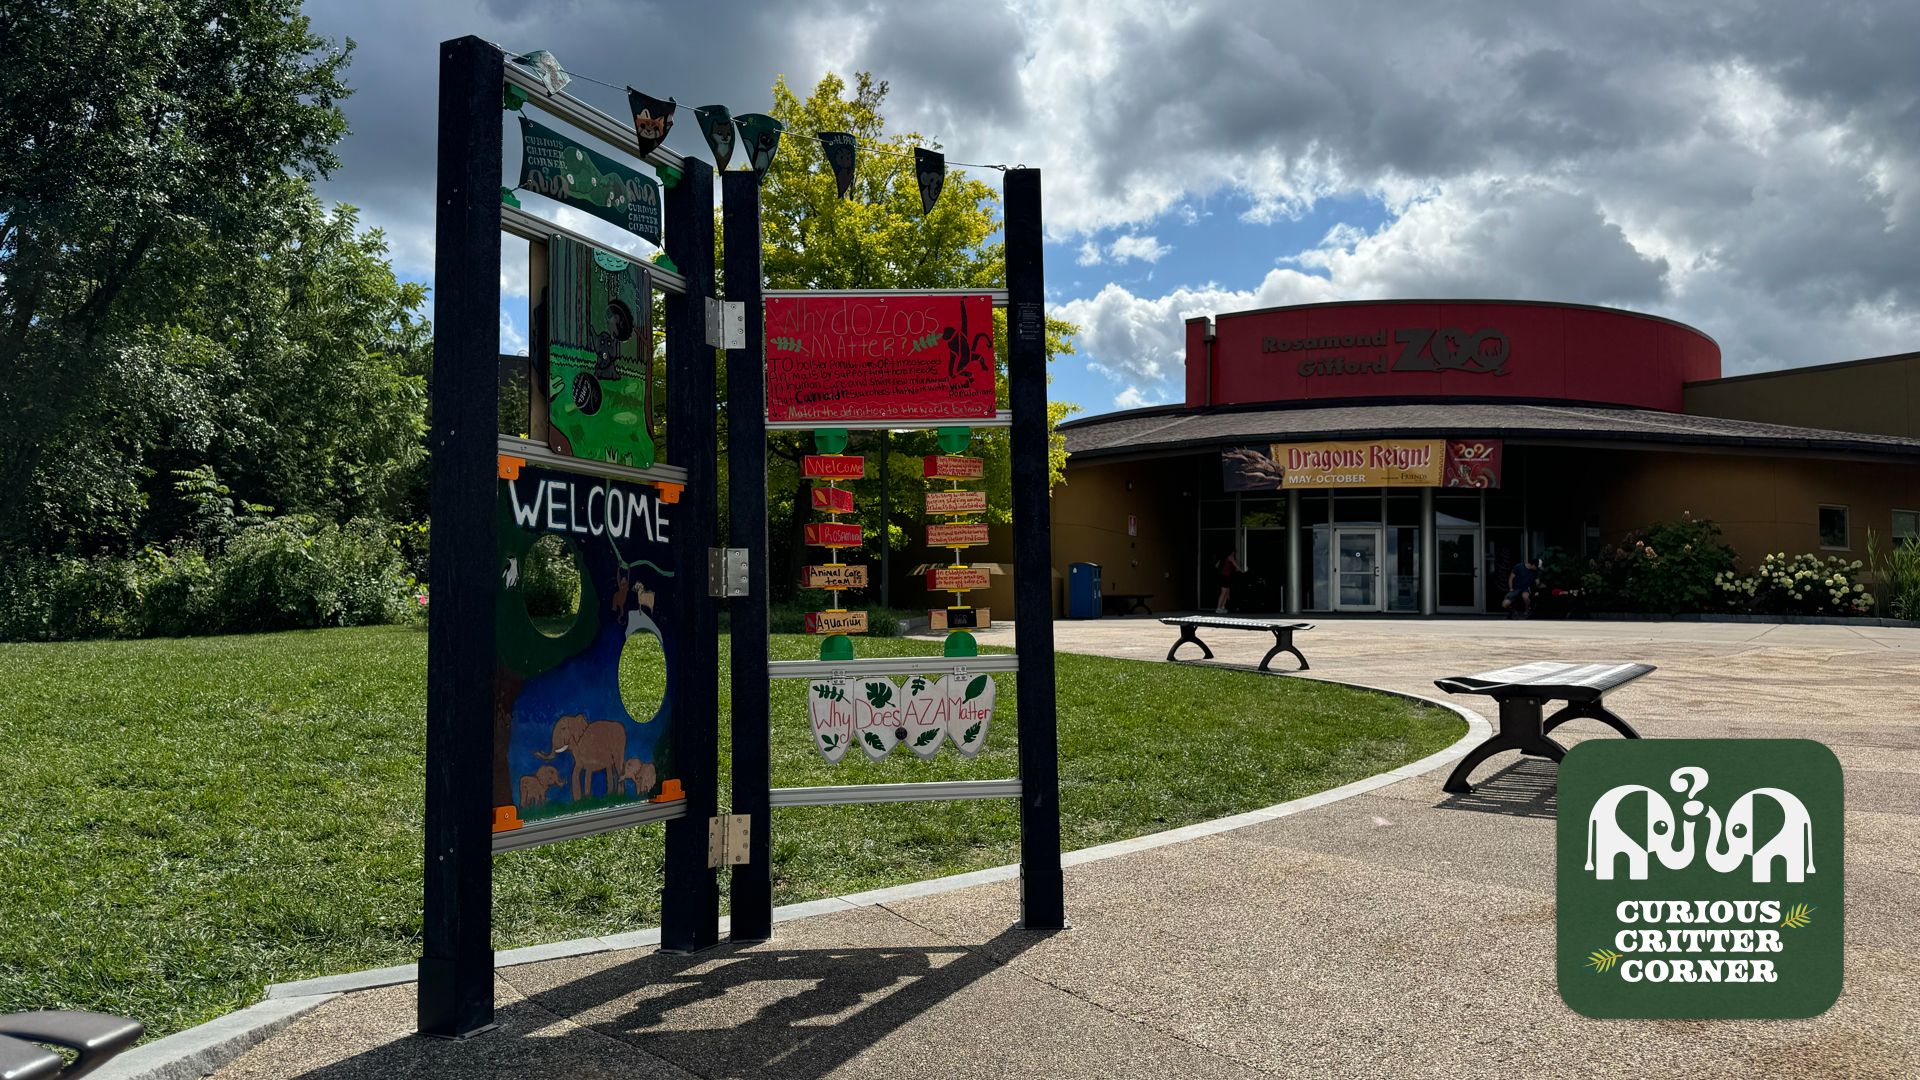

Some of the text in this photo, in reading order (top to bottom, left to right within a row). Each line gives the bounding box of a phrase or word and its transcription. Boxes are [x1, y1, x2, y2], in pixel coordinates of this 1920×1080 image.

[525, 136, 564, 149] CURIOUS
[526, 145, 565, 159] CRITTER
[628, 203, 658, 215] CURIOUS
[628, 214, 659, 225] CRITTER
[628, 223, 659, 235] CORNER
[1262, 329, 1388, 353] Rosamond
[1391, 327, 1512, 376] ZOO
[1297, 355, 1388, 378] Gifford
[1287, 442, 1432, 473] Dragons Reign!
[1288, 474, 1367, 484] MAY-OCTOBER
[508, 479, 670, 544] WELCOME
[810, 567, 841, 578] Animal
[815, 614, 862, 630] Aquarium
[812, 699, 851, 744] Why
[855, 698, 901, 730] Does
[948, 696, 992, 721] Matter
